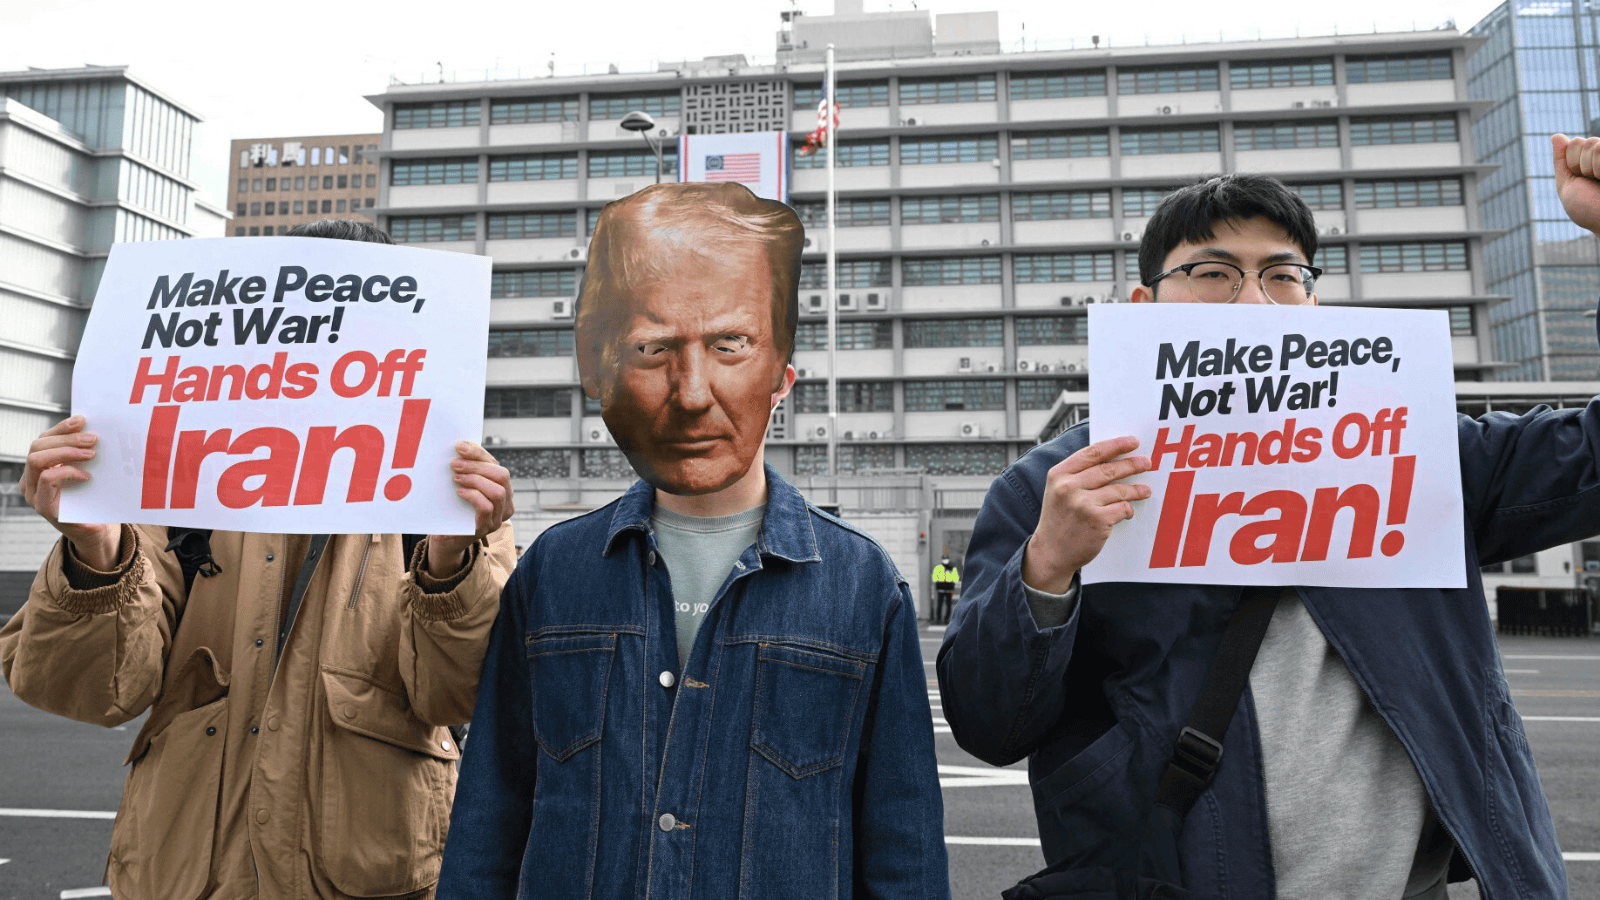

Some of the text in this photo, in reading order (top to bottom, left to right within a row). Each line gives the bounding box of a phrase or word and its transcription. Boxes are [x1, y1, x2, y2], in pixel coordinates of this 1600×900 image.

[147, 265, 426, 313] Make Peace,
[141, 306, 345, 349] Not War!
[129, 349, 427, 404] Hands Off
[1156, 334, 1401, 380] Make Peace,
[1159, 371, 1339, 420] Not War!
[141, 399, 431, 510] Iran!
[1149, 406, 1408, 471] Hands Off
[1149, 455, 1416, 569] Iran!
[675, 600, 690, 612] to
